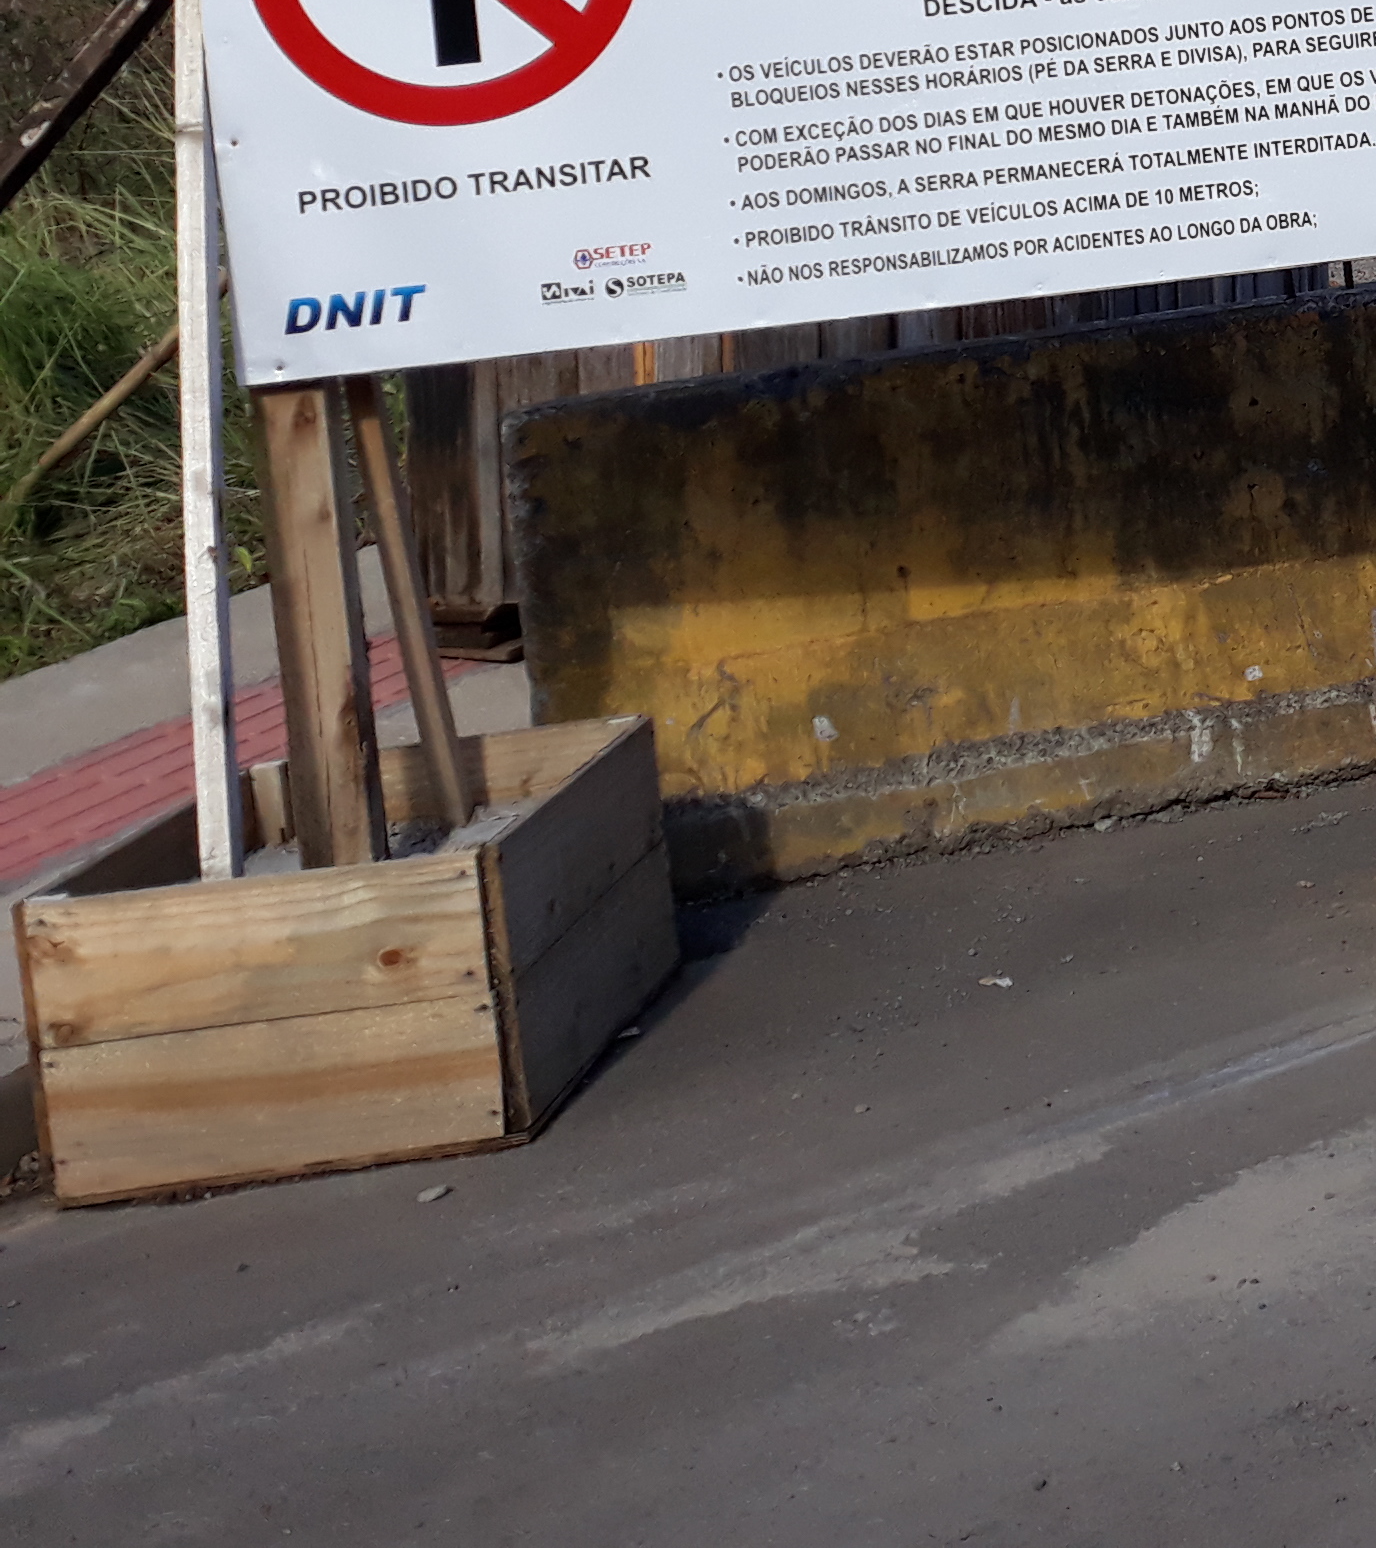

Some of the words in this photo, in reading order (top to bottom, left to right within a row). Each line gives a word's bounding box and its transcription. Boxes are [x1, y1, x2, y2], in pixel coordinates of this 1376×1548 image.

[728, 63, 756, 83] OS
[758, 54, 855, 80] VEÍCULOS
[858, 44, 951, 71] DEVERÃO
[953, 39, 1016, 63] ESTAR
[1018, 25, 1160, 56] POSICIONADOS
[1163, 19, 1225, 43] JUNTO
[1228, 15, 1268, 36] AOS
[1270, 8, 1347, 32] PONTOS
[1349, 5, 1376, 25] DE
[730, 81, 842, 109] BLOQUEIOS
[845, 73, 921, 98] NESSES
[924, 64, 1024, 90] HORÁRIOS
[1027, 60, 1059, 85] (PÉ
[1062, 58, 1091, 78] DA
[1092, 51, 1158, 75] SERRA
[1159, 49, 1173, 68] E
[1176, 43, 1249, 67] DIVISA),
[1251, 37, 1302, 59] PARA
[734, 126, 779, 148] COM
[782, 117, 874, 143] EXCEÇÃO
[878, 112, 919, 134] DOS
[922, 108, 968, 130] DIAS
[971, 104, 1000, 125] EM
[1003, 100, 1045, 122] QUE
[1047, 92, 1127, 117] HOUVER
[1129, 79, 1261, 110] DETONAÇÕES,
[1264, 76, 1293, 97] EM
[1295, 72, 1336, 93] QUE
[1338, 69, 1366, 89] OS
[736, 147, 831, 173] PODERÃO
[834, 139, 911, 164] PASSAR
[914, 136, 943, 156] NO
[947, 131, 1002, 153] FINAL
[1005, 127, 1034, 147] DO
[1037, 119, 1107, 144] MESMO
[1110, 116, 1144, 137] DIA
[1145, 114, 1159, 133] E
[1161, 106, 1240, 131] TAMBÉM
[1243, 104, 1271, 123] NA
[1273, 93, 1341, 121] MANHÃ
[1343, 93, 1372, 114] DO
[297, 175, 459, 215] PROIBIDO
[466, 155, 652, 197] TRANSITAR
[740, 190, 781, 211] AOS
[785, 179, 893, 207] DOMINGOS,
[896, 177, 912, 196] A
[913, 170, 980, 194] SERRA
[982, 155, 1125, 187] PERMANECERÁ
[1127, 142, 1250, 172] TOTALMENTE
[1252, 131, 1376, 160] INTERDITADA.
[744, 222, 836, 249] PROIBIDO
[838, 212, 933, 238] TRÂNSITO
[936, 208, 963, 229] DE
[965, 199, 1059, 225] VEÍCULOS
[1062, 192, 1122, 216] ACIMA
[1124, 189, 1151, 209] DE
[1154, 187, 1175, 206] 10
[1178, 178, 1260, 204] METROS;
[746, 264, 785, 287] NÃO
[787, 261, 825, 282] NOS
[827, 240, 1010, 278] RESPONSABILIZAMOS
[1012, 237, 1050, 257] POR
[1051, 227, 1146, 254] ACIDENTES
[1148, 224, 1174, 244] AO
[1176, 218, 1236, 241] LONGO
[1238, 215, 1264, 235] DA
[1265, 210, 1318, 232] OBRA;
[593, 242, 652, 260] SETEP
[626, 271, 686, 289] SOTEPA
[283, 283, 427, 336] DNIT
